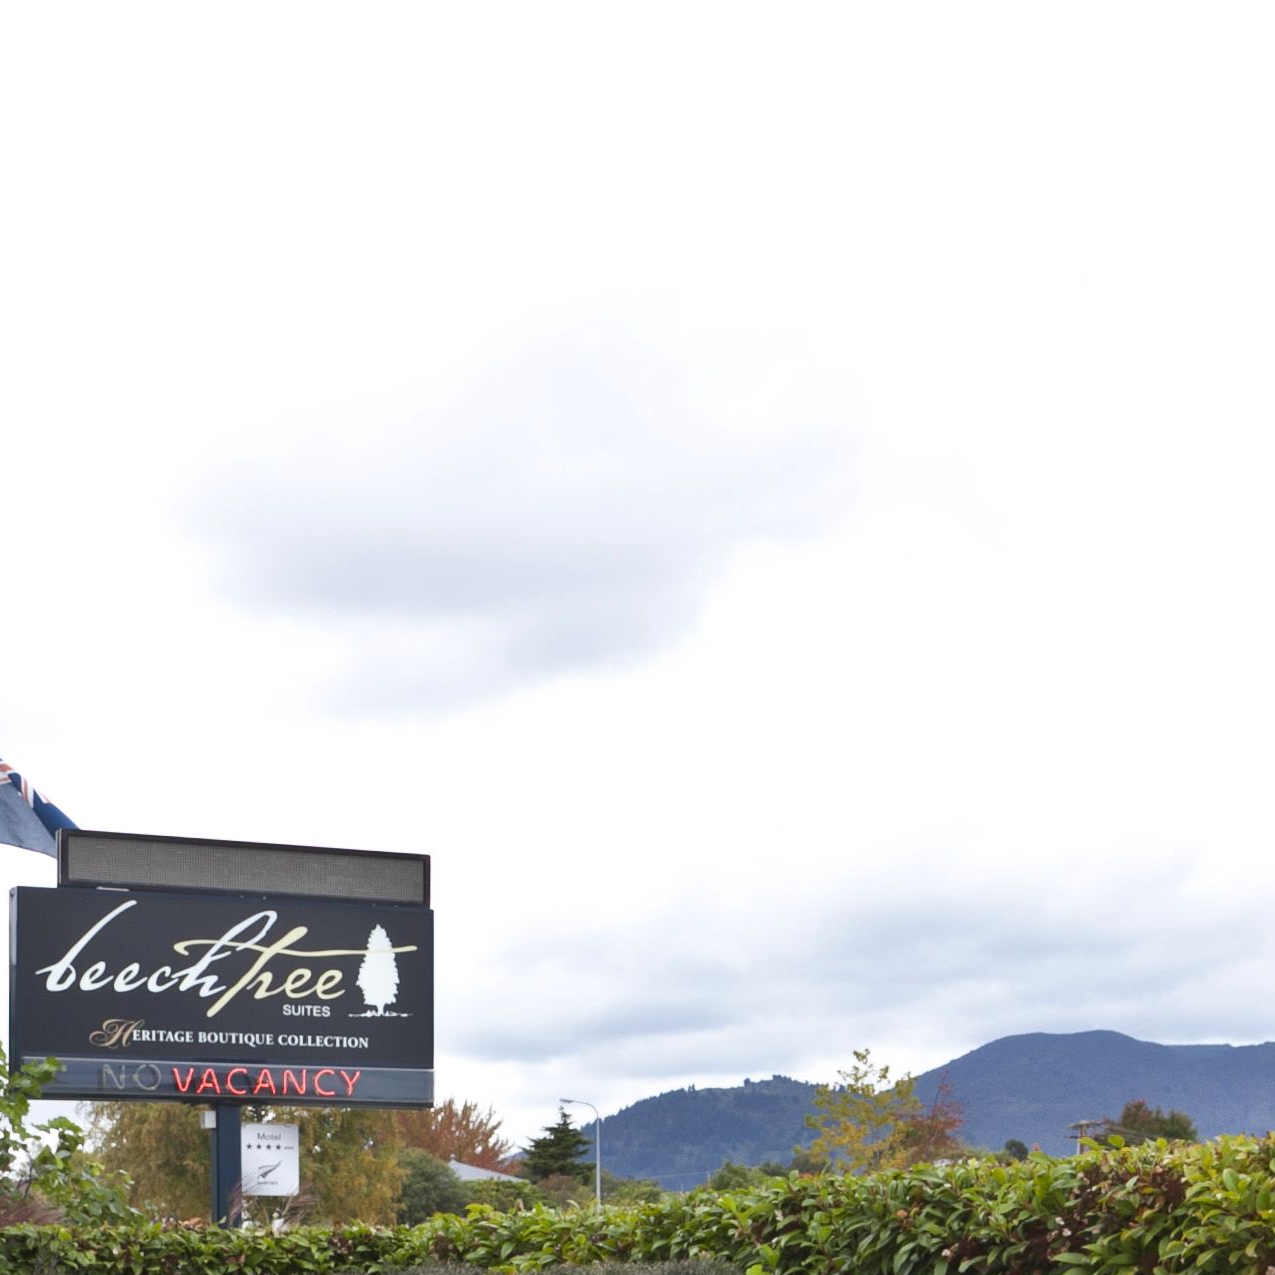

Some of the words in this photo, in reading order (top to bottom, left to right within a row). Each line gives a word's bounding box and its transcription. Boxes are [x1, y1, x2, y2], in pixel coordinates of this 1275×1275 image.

[282, 1003, 331, 1018] SUITES
[198, 1031, 274, 1048] BOUTIQUE
[278, 1034, 370, 1049] COLLECTION
[101, 1062, 163, 1091] NO
[172, 1066, 362, 1096] VACANCY
[257, 1132, 282, 1141] Motel
